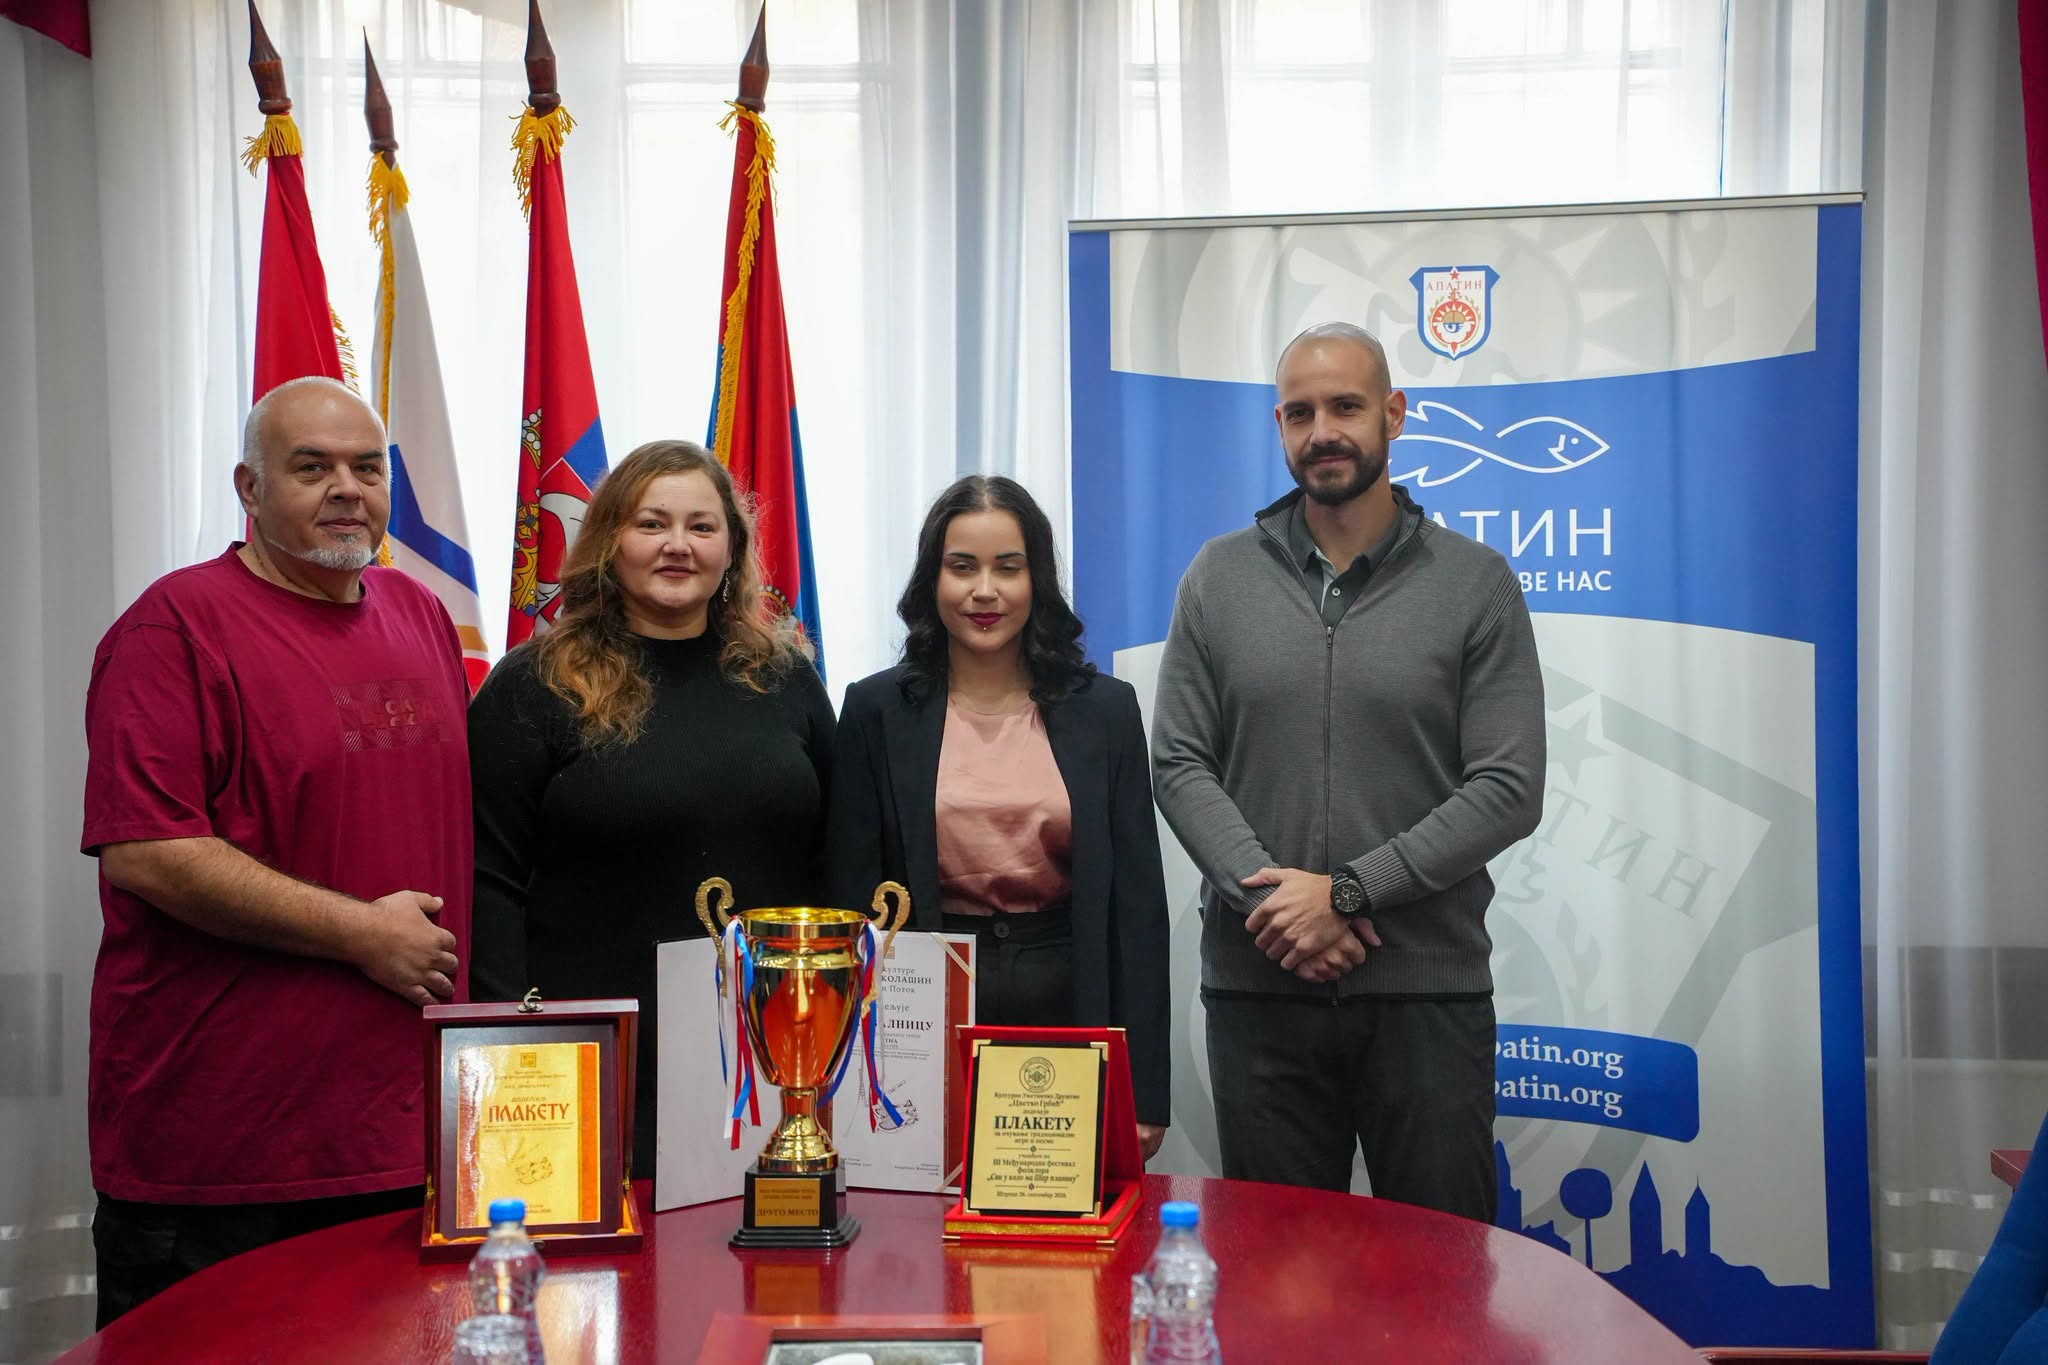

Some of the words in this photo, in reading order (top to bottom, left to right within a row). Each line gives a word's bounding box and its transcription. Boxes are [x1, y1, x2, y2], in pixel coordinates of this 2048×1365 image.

[1427, 280, 1482, 291] АПАТИН
[1433, 508, 1611, 558] ТИН
[1521, 571, 1548, 593] ВЕ
[1557, 570, 1612, 592] НАС
[1541, 785, 1721, 918] ТИН
[884, 1003, 910, 1012] ељује
[883, 1019, 934, 1031] ЛНИЦУ
[1495, 1036, 1624, 1079] atin.org
[1495, 1075, 1623, 1119] atin.org
[489, 1102, 570, 1122] ПЛАКЕТУ
[994, 1115, 1076, 1131] ПЛАКЕТУ
[787, 1208, 819, 1216] МЕСТО
